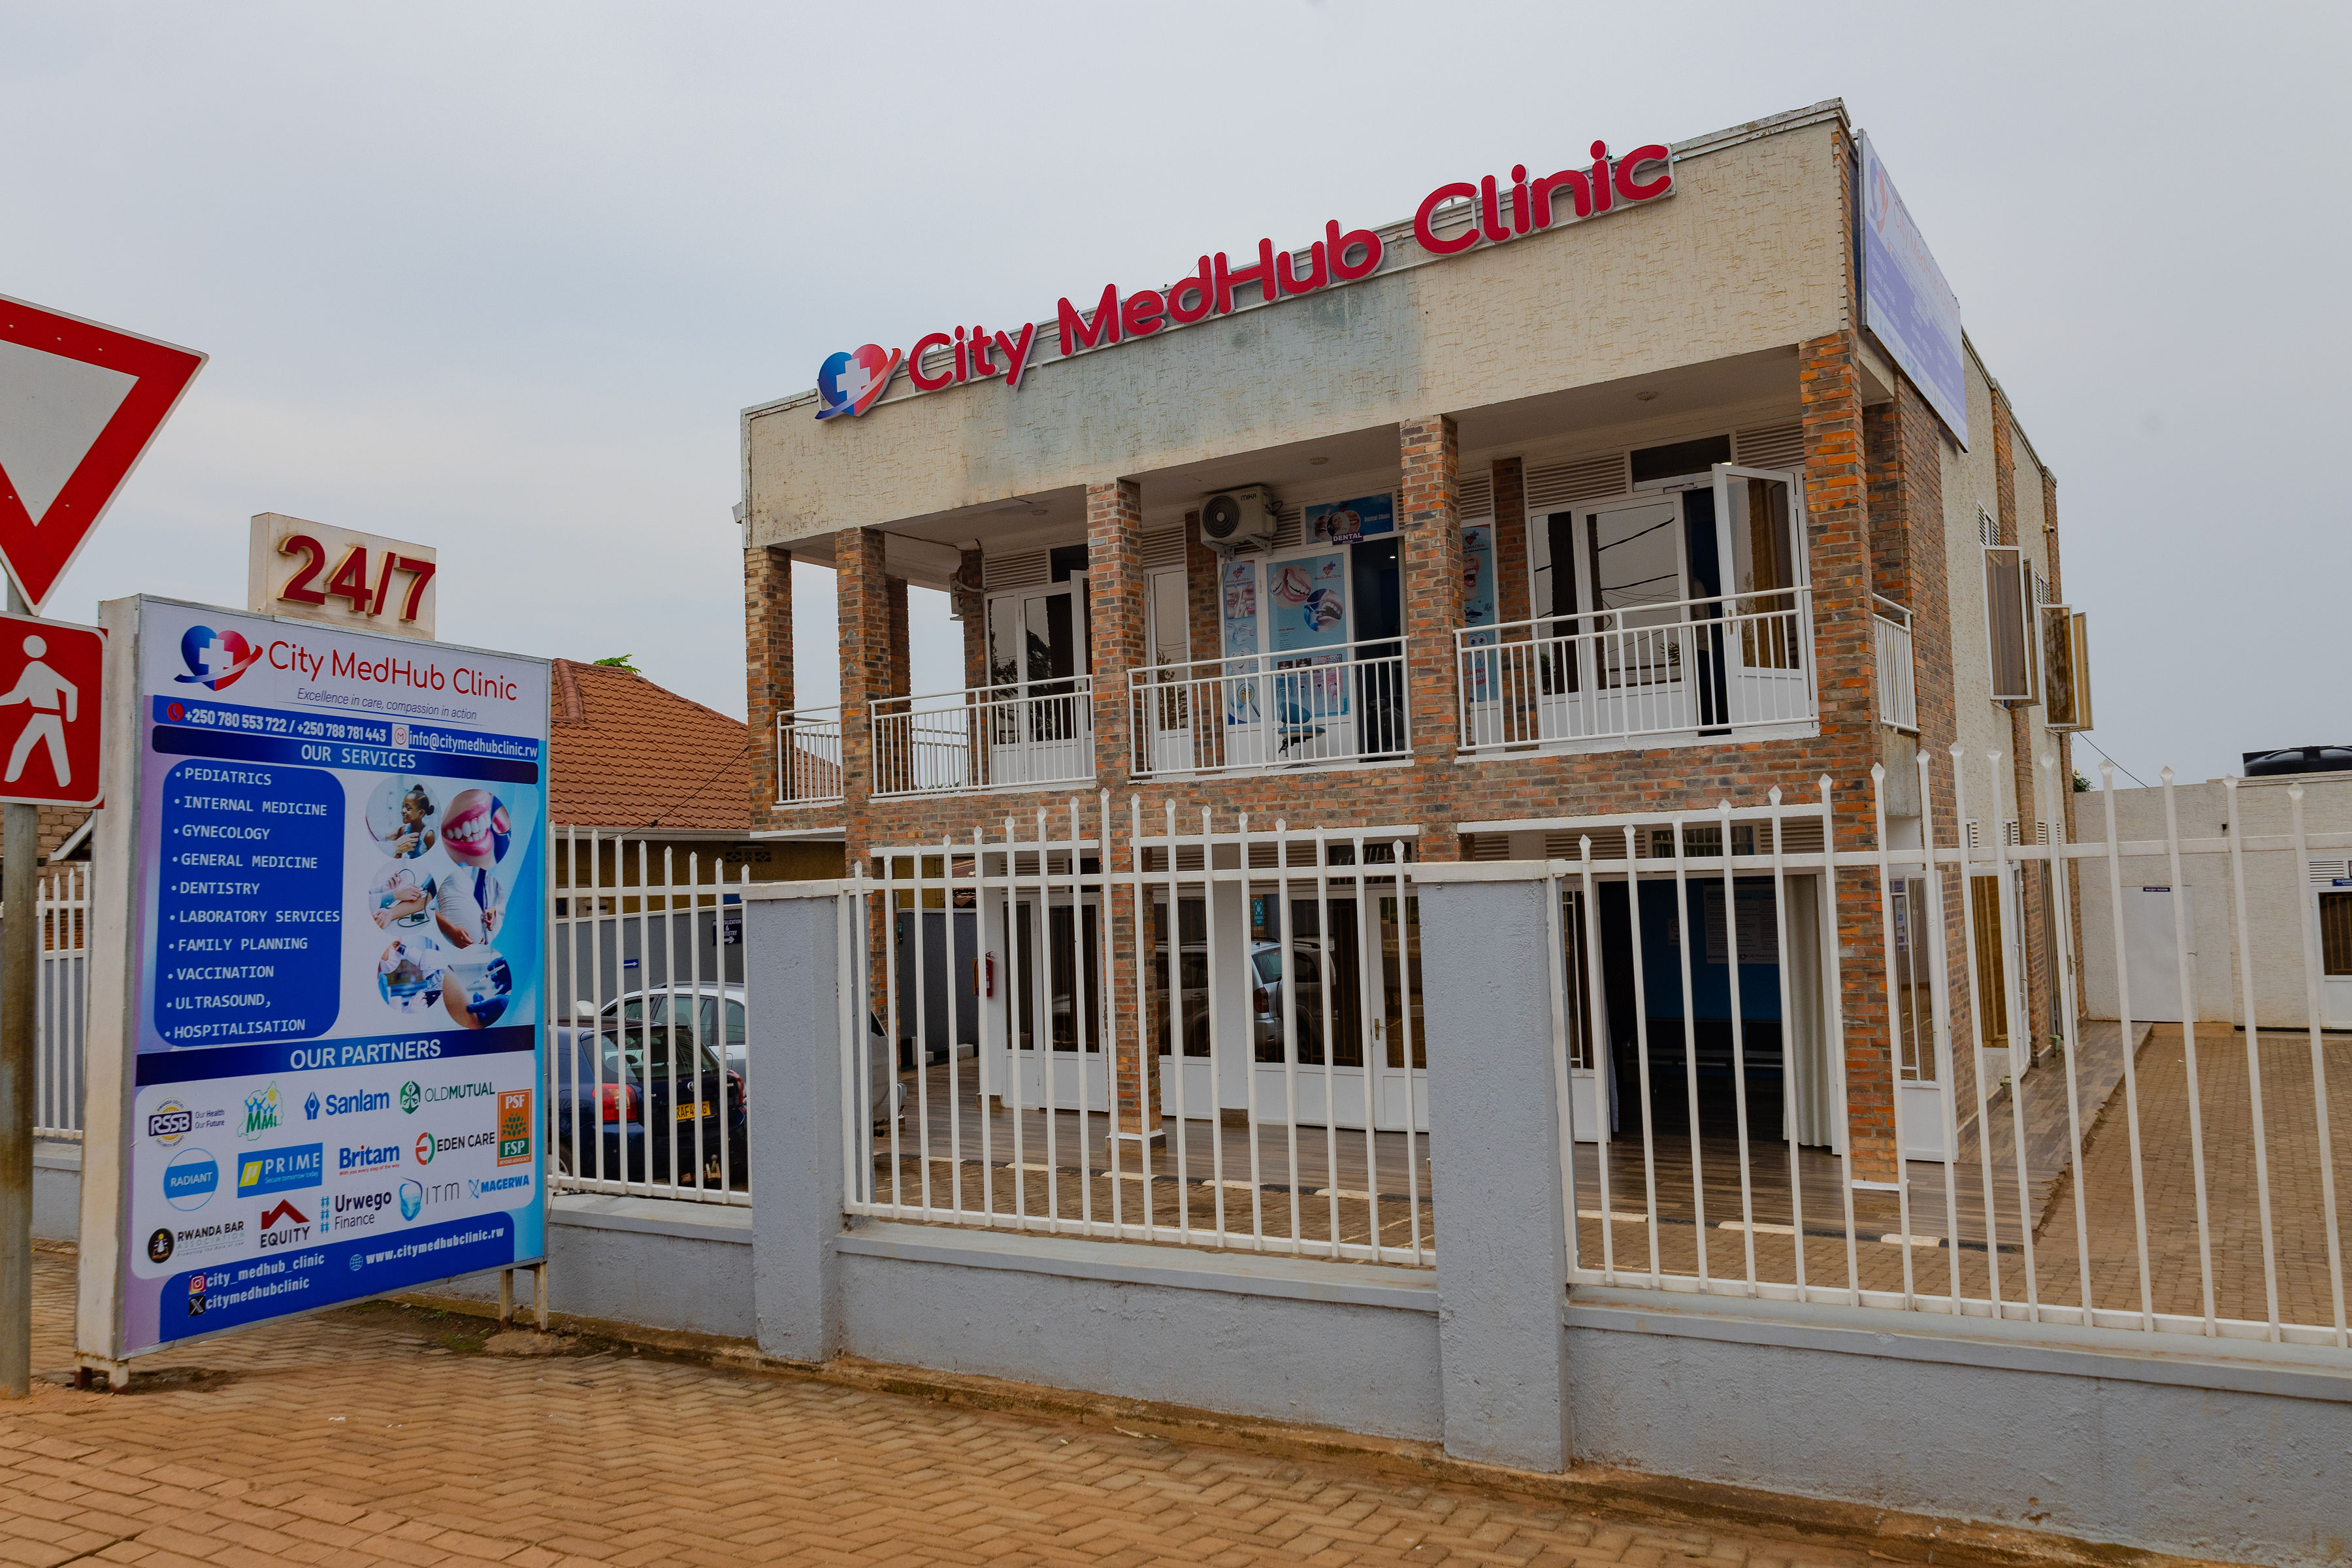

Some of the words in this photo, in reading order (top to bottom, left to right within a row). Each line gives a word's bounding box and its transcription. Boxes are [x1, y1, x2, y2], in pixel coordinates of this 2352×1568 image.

[908, 324, 1036, 391] City
[1056, 220, 1384, 356] MedHub
[1414, 140, 1673, 255] Clinic
[1333, 532, 1363, 542] DENTAL
[280, 535, 436, 621] 24/7
[269, 640, 324, 681] City
[332, 649, 445, 691] MedHub
[453, 668, 517, 701] Clinic
[297, 688, 349, 705] Excellence
[351, 693, 359, 706] in
[362, 697, 384, 710] care,
[386, 701, 440, 717] compassion
[442, 705, 451, 717] in
[451, 707, 477, 720] action
[186, 709, 216, 725] +250
[218, 711, 240, 728] 780
[242, 714, 263, 730] 553
[265, 717, 287, 732] 722
[289, 720, 296, 733] /
[297, 721, 324, 736] +250
[327, 723, 346, 738] 788
[409, 730, 538, 758] info@citymedhubclinic.rw
[301, 744, 332, 762] OUR
[342, 747, 416, 770] SERVICES
[184, 767, 272, 785] PEDIATRICS
[184, 795, 254, 812] INTERNAL
[262, 801, 327, 816] MEDICINE
[182, 824, 270, 840] GYNECOLOGY
[181, 853, 243, 867] GENERAL
[252, 855, 318, 869] MEDICINE
[180, 881, 261, 894] DENTISTRY
[179, 910, 268, 923] LABORATORY
[276, 910, 340, 923] SERVICES
[178, 938, 233, 951] FAMILY
[241, 938, 308, 951] PLANNING
[176, 965, 274, 981] VACCINATION
[175, 993, 272, 1010] ULTRASOUND,
[174, 1019, 306, 1039] HOSPITALISATION
[290, 1047, 336, 1070] OUR
[341, 1039, 442, 1066] PARTNERS
[326, 1088, 390, 1116] Sanlam
[505, 1094, 525, 1109] PSF
[206, 1109, 225, 1117] Health
[150, 1113, 190, 1135] RSSB
[437, 1135, 465, 1152] EDEN
[468, 1132, 495, 1147] CARE
[504, 1140, 525, 1156] FSP
[265, 1152, 321, 1175] PRIME
[338, 1145, 400, 1169] Britam
[171, 1171, 214, 1188] RADIANT
[481, 1174, 530, 1194] MAGERWA
[335, 1191, 392, 1213] Urwego
[178, 1224, 221, 1242] RWANDA
[224, 1220, 244, 1233] BAR
[335, 1212, 375, 1230] Finance
[177, 1232, 245, 1249] ASSOCIATION
[261, 1226, 310, 1249] EQUITY
[366, 1227, 504, 1266] www.citymedhubclinic.rw
[206, 1252, 325, 1288] city_medhub_clinic
[205, 1276, 310, 1309] citymedhubclinic
